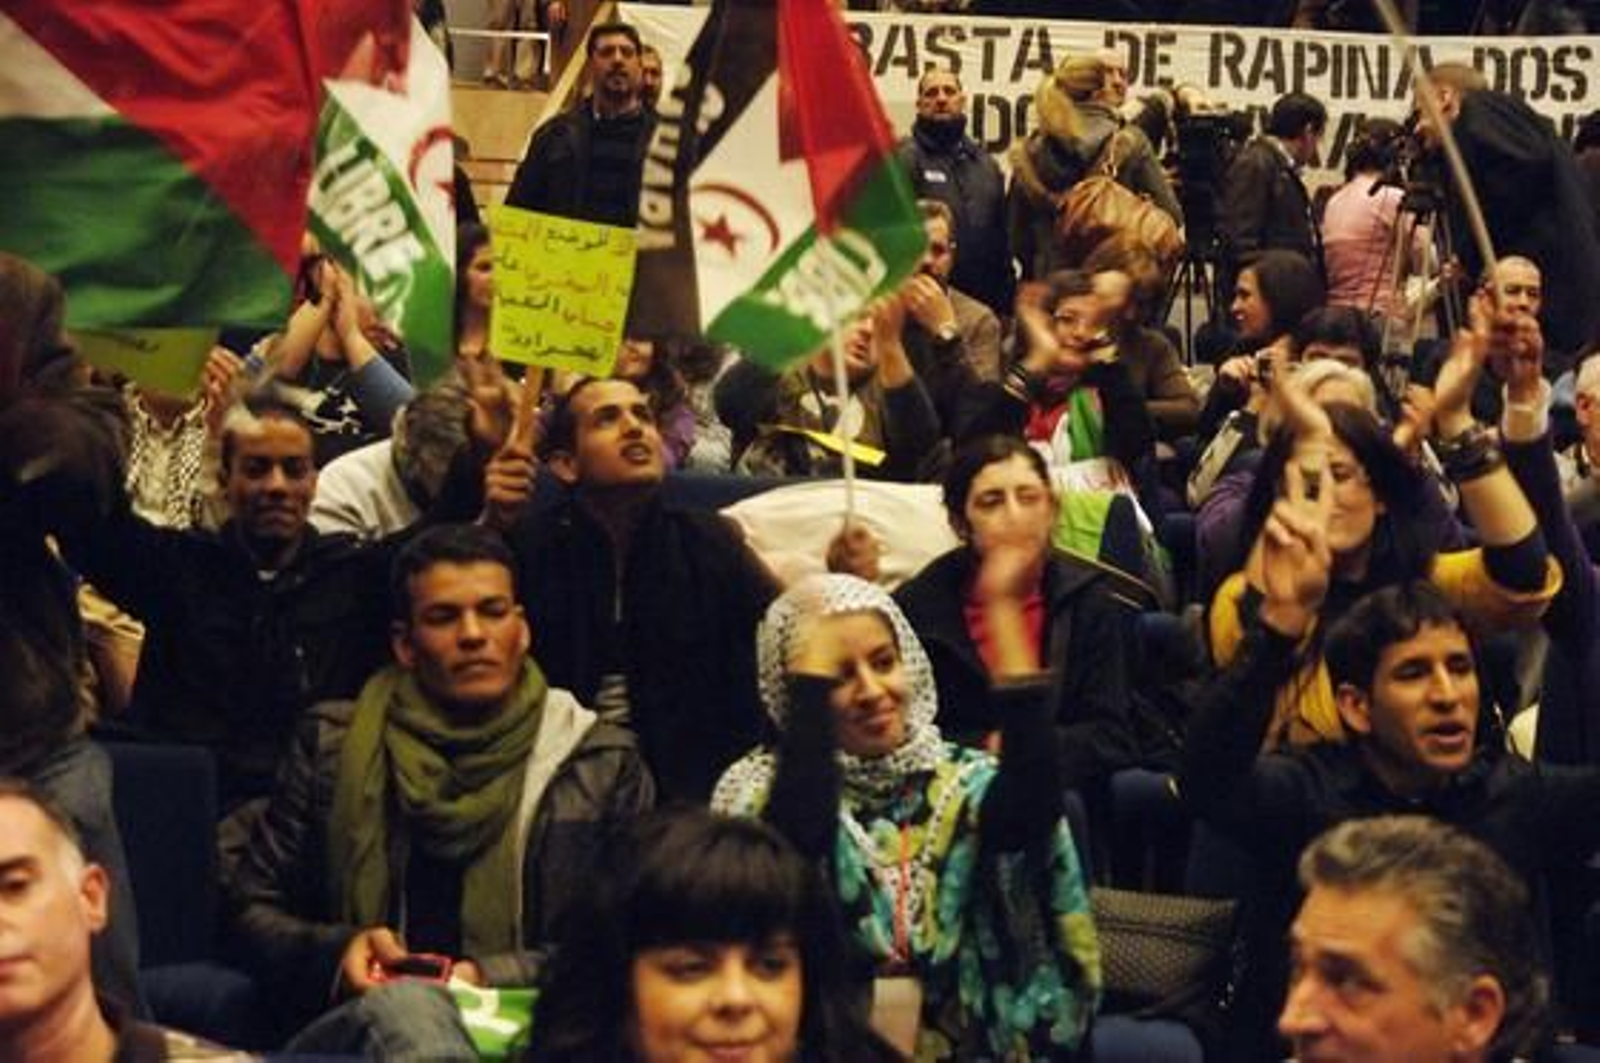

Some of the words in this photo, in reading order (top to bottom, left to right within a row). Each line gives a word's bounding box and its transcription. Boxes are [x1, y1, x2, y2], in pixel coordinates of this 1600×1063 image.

[1103, 29, 1177, 88] DE
[1207, 32, 1434, 100] RAPINA
[1473, 45, 1592, 102] DOS
[307, 138, 425, 282] LIBRE
